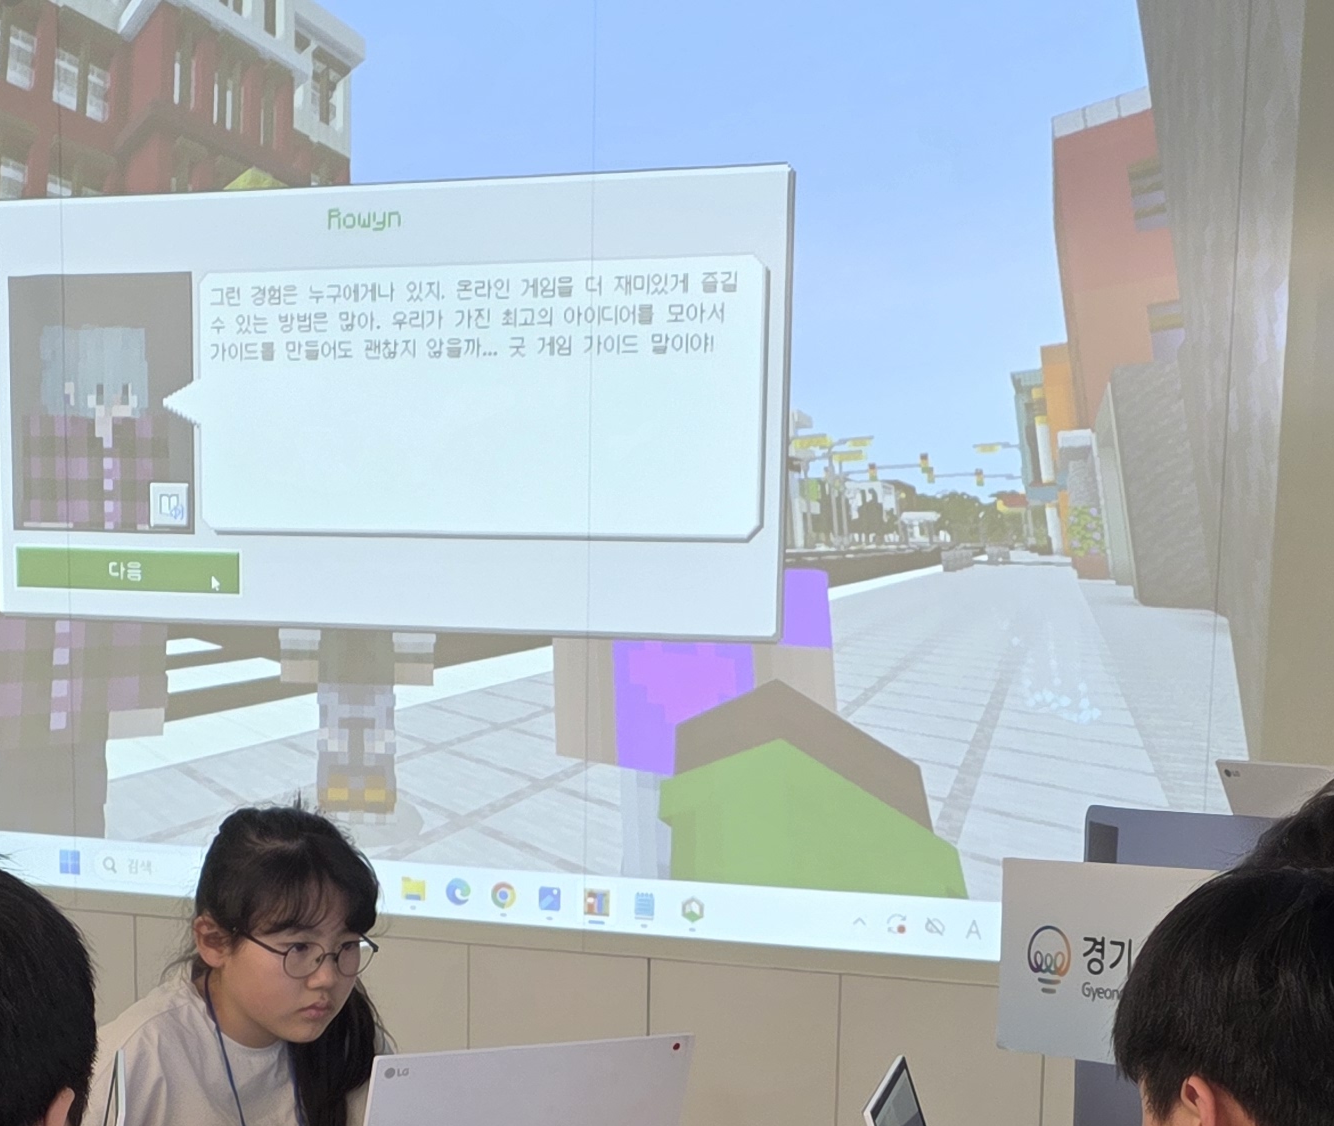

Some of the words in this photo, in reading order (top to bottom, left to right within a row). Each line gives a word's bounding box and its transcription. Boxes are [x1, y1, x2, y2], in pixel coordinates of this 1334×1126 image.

[327, 206, 402, 232] Rowyn
[210, 286, 241, 307] 그런
[251, 284, 298, 307] 경험은
[308, 281, 395, 304] 누구에게나
[406, 280, 445, 302] 있지.
[456, 278, 510, 300] 온라인
[520, 276, 574, 299] 게임을
[584, 275, 603, 296] 더
[615, 272, 689, 296] 재미있게
[701, 270, 738, 294] 즐길
[210, 316, 226, 332] 수
[235, 314, 268, 334] 있는
[278, 312, 329, 333] 방법은
[338, 311, 381, 331] 많아.
[392, 309, 443, 330] 우리가
[455, 308, 491, 329] 가진
[501, 306, 554, 327] 최고의
[563, 303, 654, 326] 아이디어를
[667, 301, 725, 323] 모아서
[210, 341, 275, 362] 가이드를
[285, 340, 353, 361] 만들어도
[364, 338, 417, 360] 괜찮지
[425, 337, 498, 359] 않을까...
[508, 336, 526, 358] 굿
[537, 335, 573, 356] 게임
[583, 333, 639, 355] 가이드
[650, 332, 715, 355] 말이야!
[108, 561, 142, 582] 다음
[1082, 936, 1133, 979] 경기
[396, 1067, 410, 1077] LG
